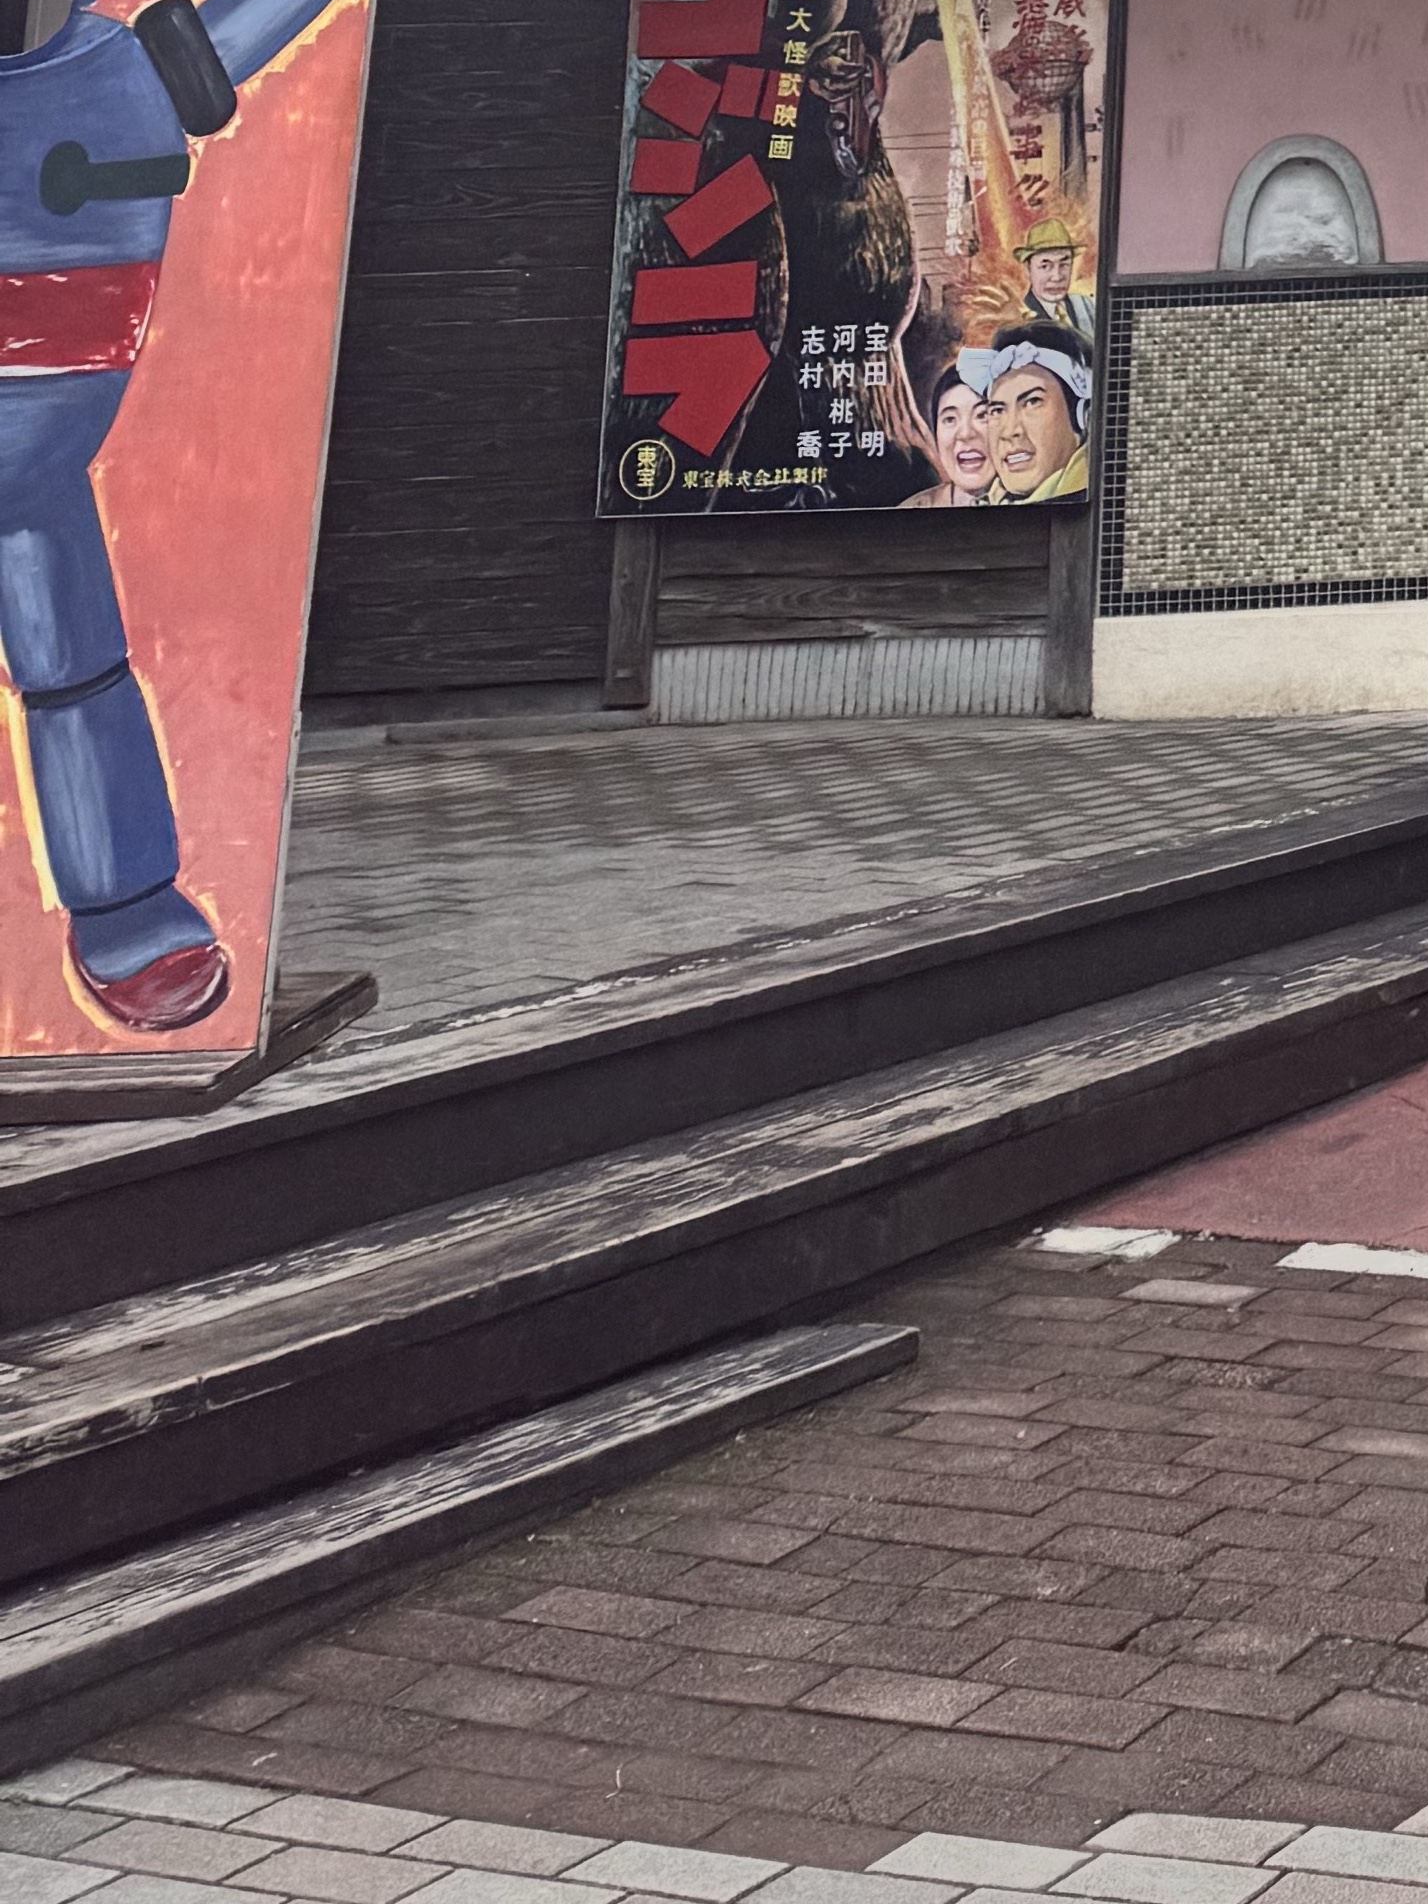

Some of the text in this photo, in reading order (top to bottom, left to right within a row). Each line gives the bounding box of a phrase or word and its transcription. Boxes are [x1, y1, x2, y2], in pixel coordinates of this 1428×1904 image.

[796, 324, 828, 461] 志村喬
[829, 322, 859, 460] 河内桃子
[860, 321, 892, 460] 宝田明
[637, 446, 657, 488] 東宝
